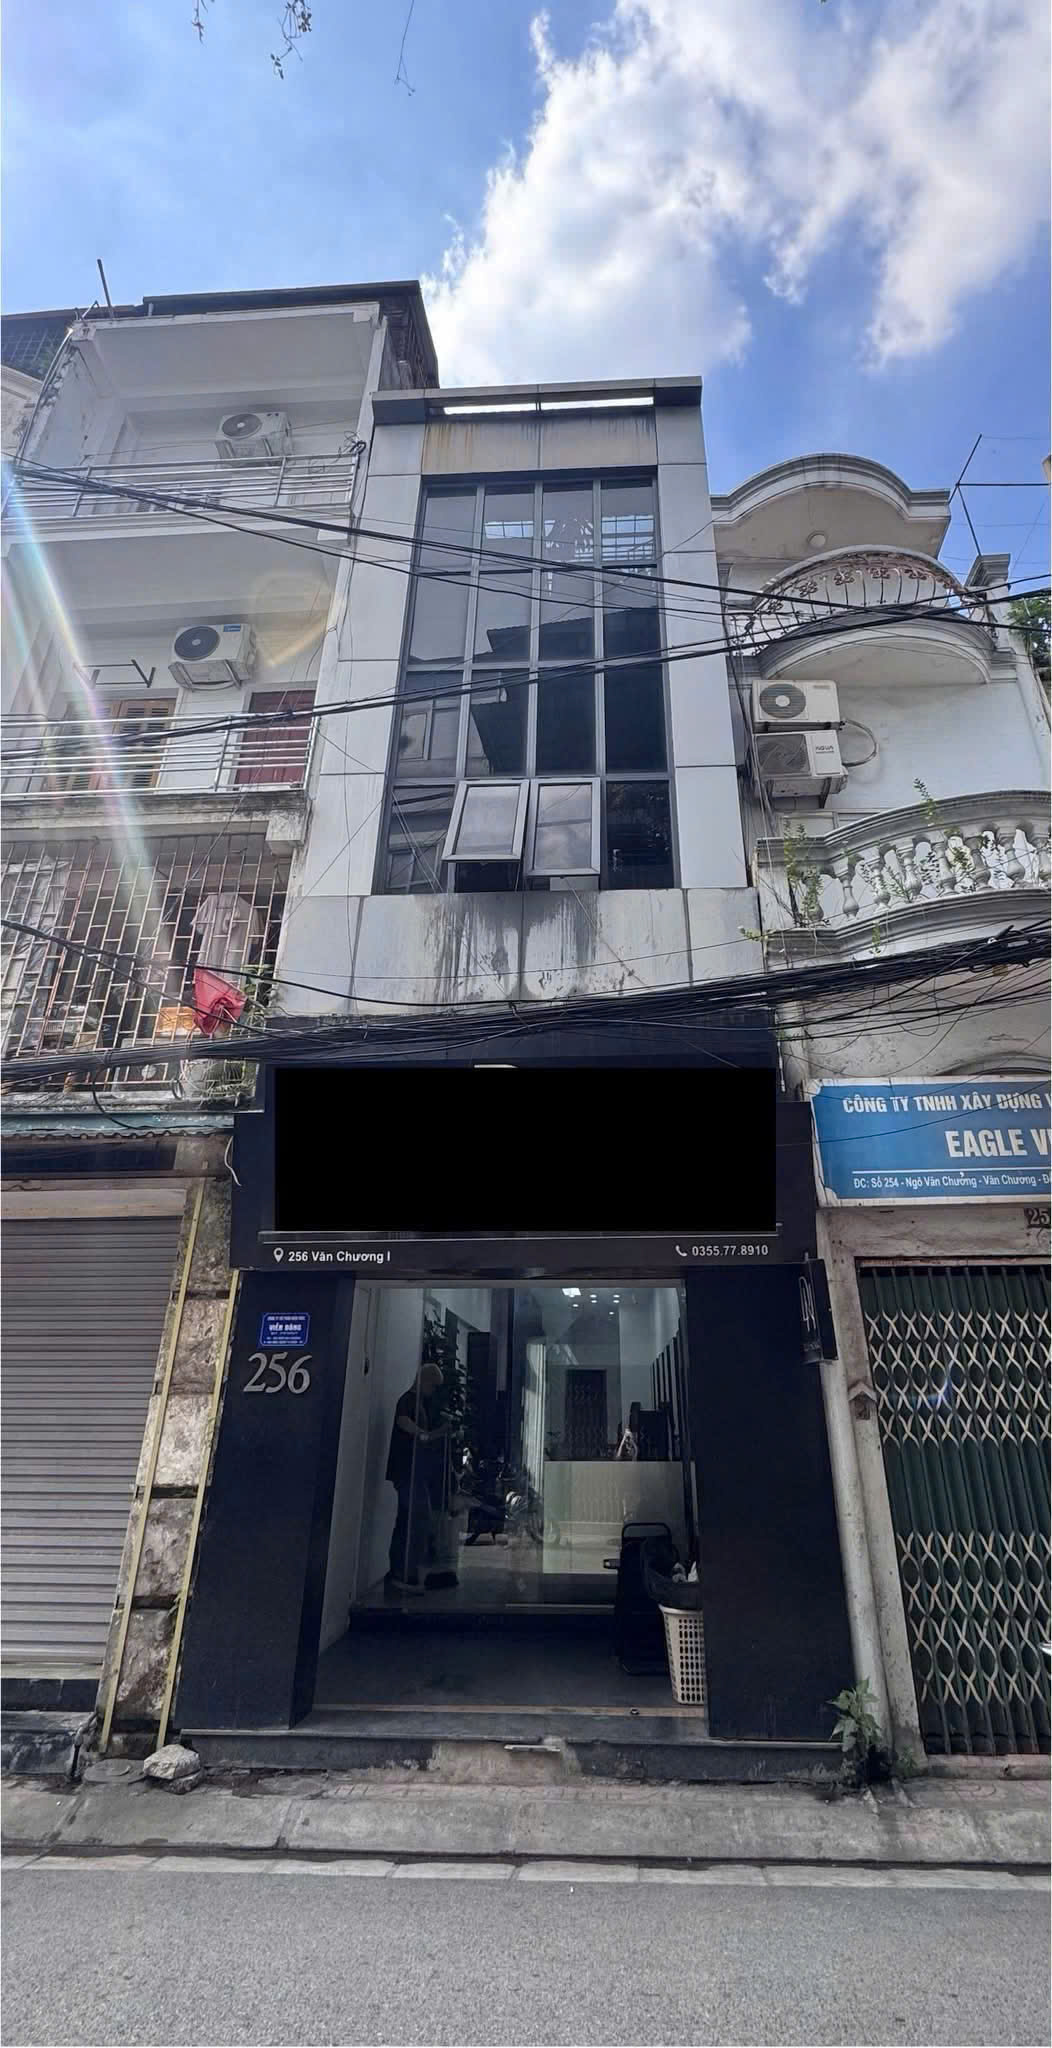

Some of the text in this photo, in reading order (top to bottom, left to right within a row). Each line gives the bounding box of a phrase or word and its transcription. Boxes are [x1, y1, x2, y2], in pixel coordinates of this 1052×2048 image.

[843, 1094, 887, 1113] CÔNG
[890, 1096, 910, 1112] TY
[911, 1095, 957, 1112] TNHH
[960, 1091, 992, 1110] XÂY
[945, 1129, 1028, 1157] EAGLE
[884, 1176, 899, 1188] 254
[288, 1251, 308, 1262] 256
[336, 1250, 384, 1264] Chương
[691, 1244, 769, 1257] 0355.77.8910
[243, 1352, 312, 1394] 256
